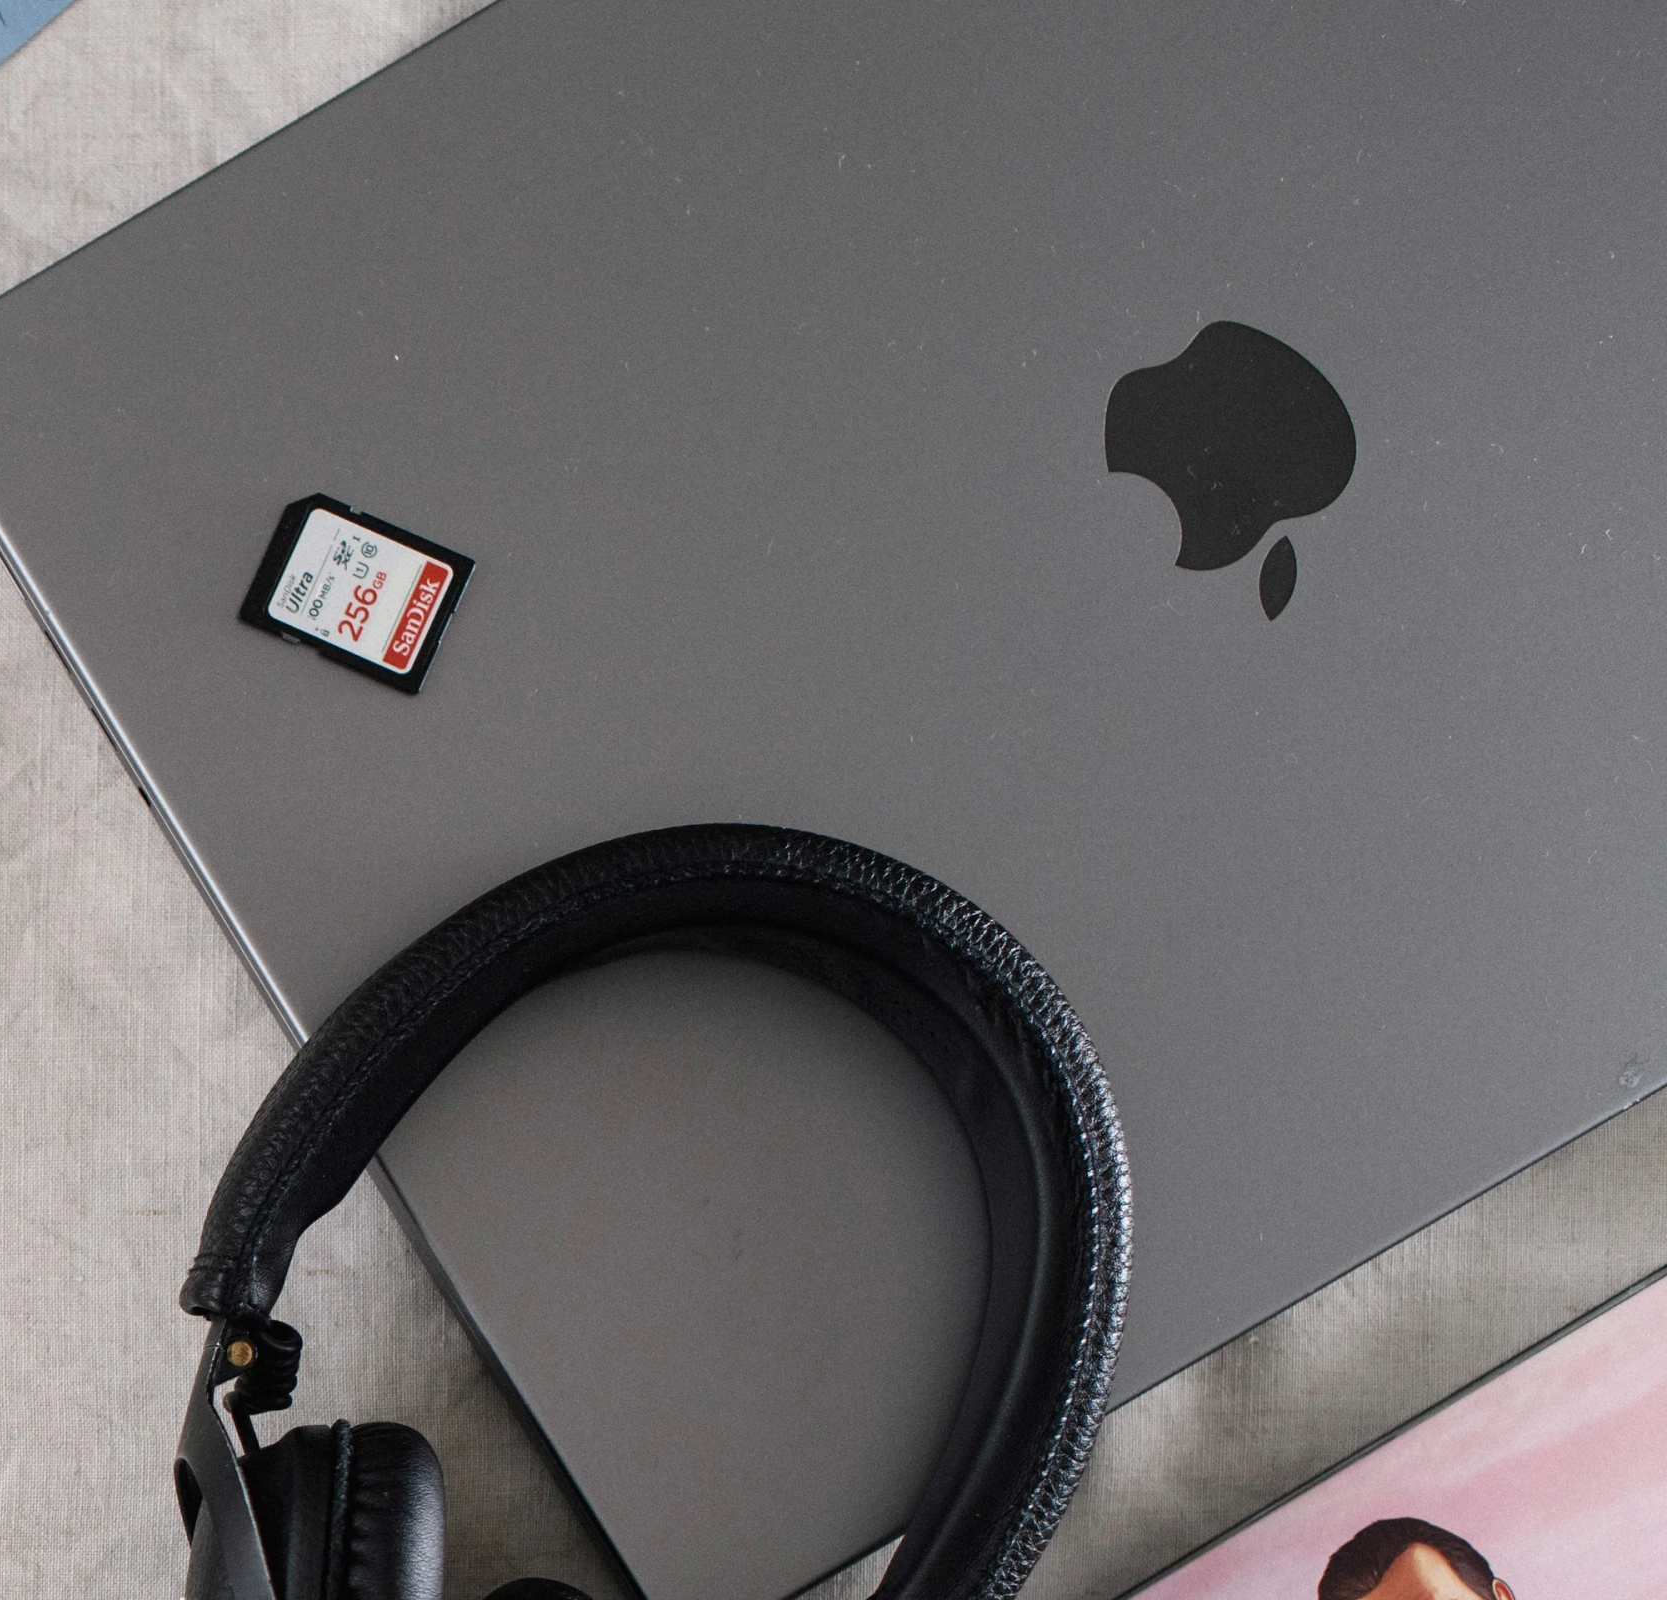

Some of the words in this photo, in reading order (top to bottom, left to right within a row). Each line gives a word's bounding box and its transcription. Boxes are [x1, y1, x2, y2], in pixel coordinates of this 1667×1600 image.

[277, 574, 298, 608] SanDisk
[285, 571, 314, 614] Ultra
[392, 578, 440, 657] SanDisk
